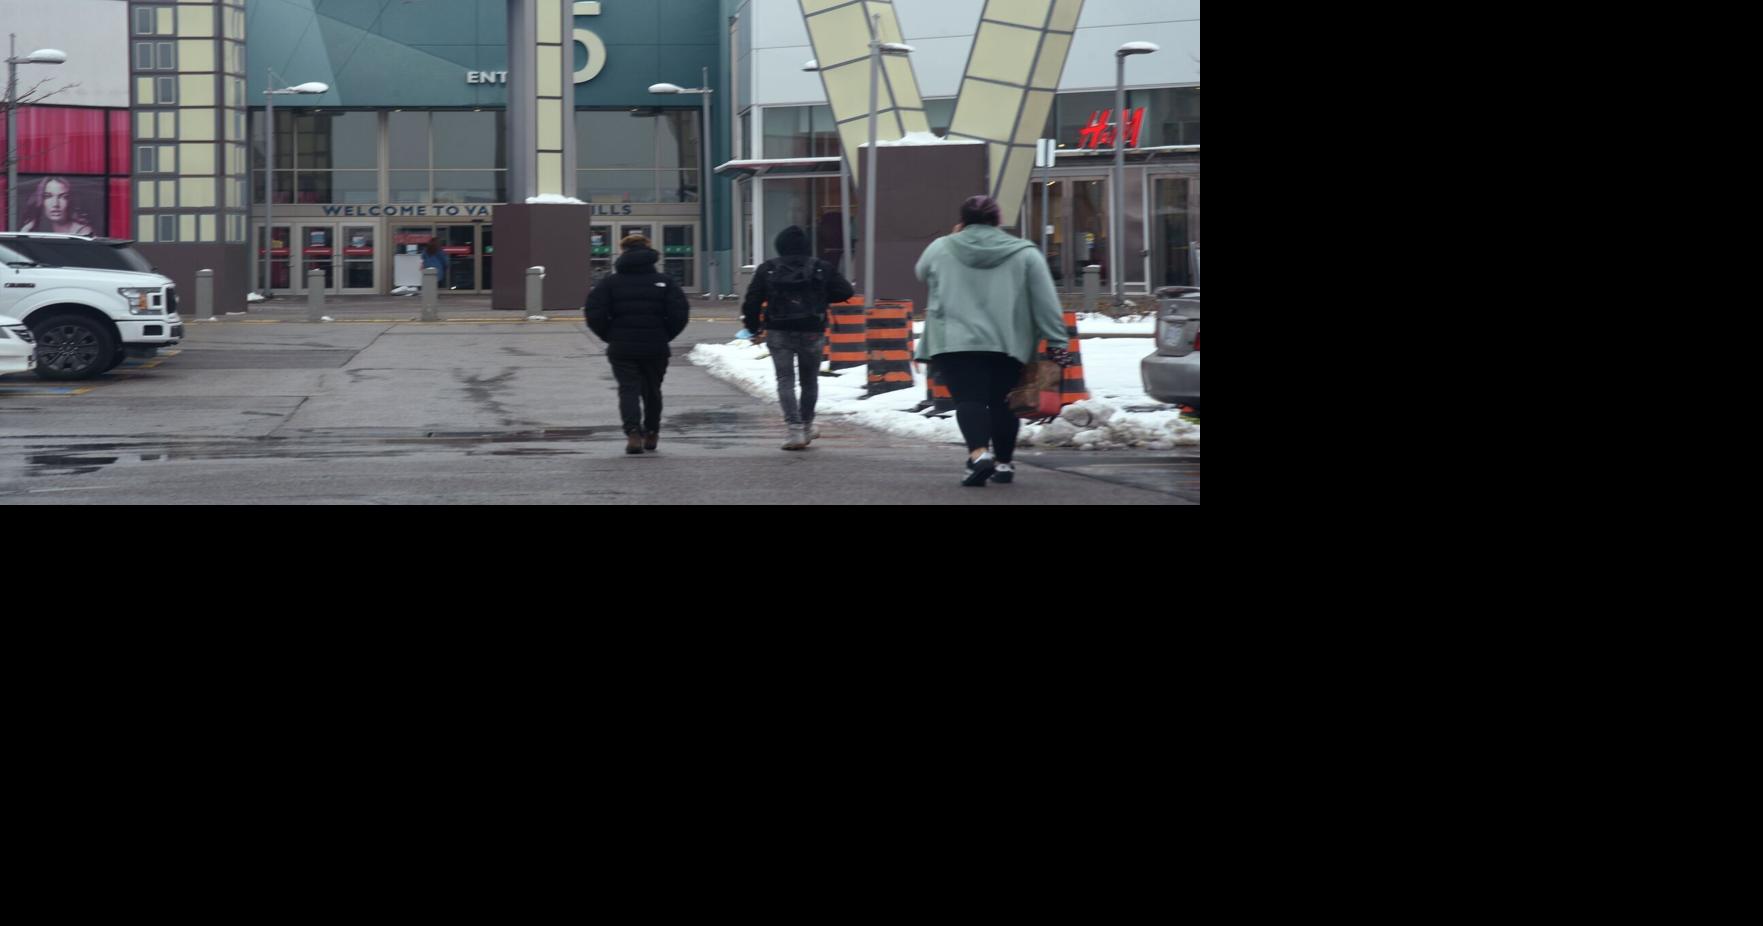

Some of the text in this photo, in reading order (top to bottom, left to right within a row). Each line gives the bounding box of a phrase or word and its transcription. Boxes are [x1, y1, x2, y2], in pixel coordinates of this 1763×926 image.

[573, 1, 606, 84] 5
[323, 205, 426, 216] WELCOME
[434, 205, 459, 216] TO
[466, 205, 489, 216] VA
